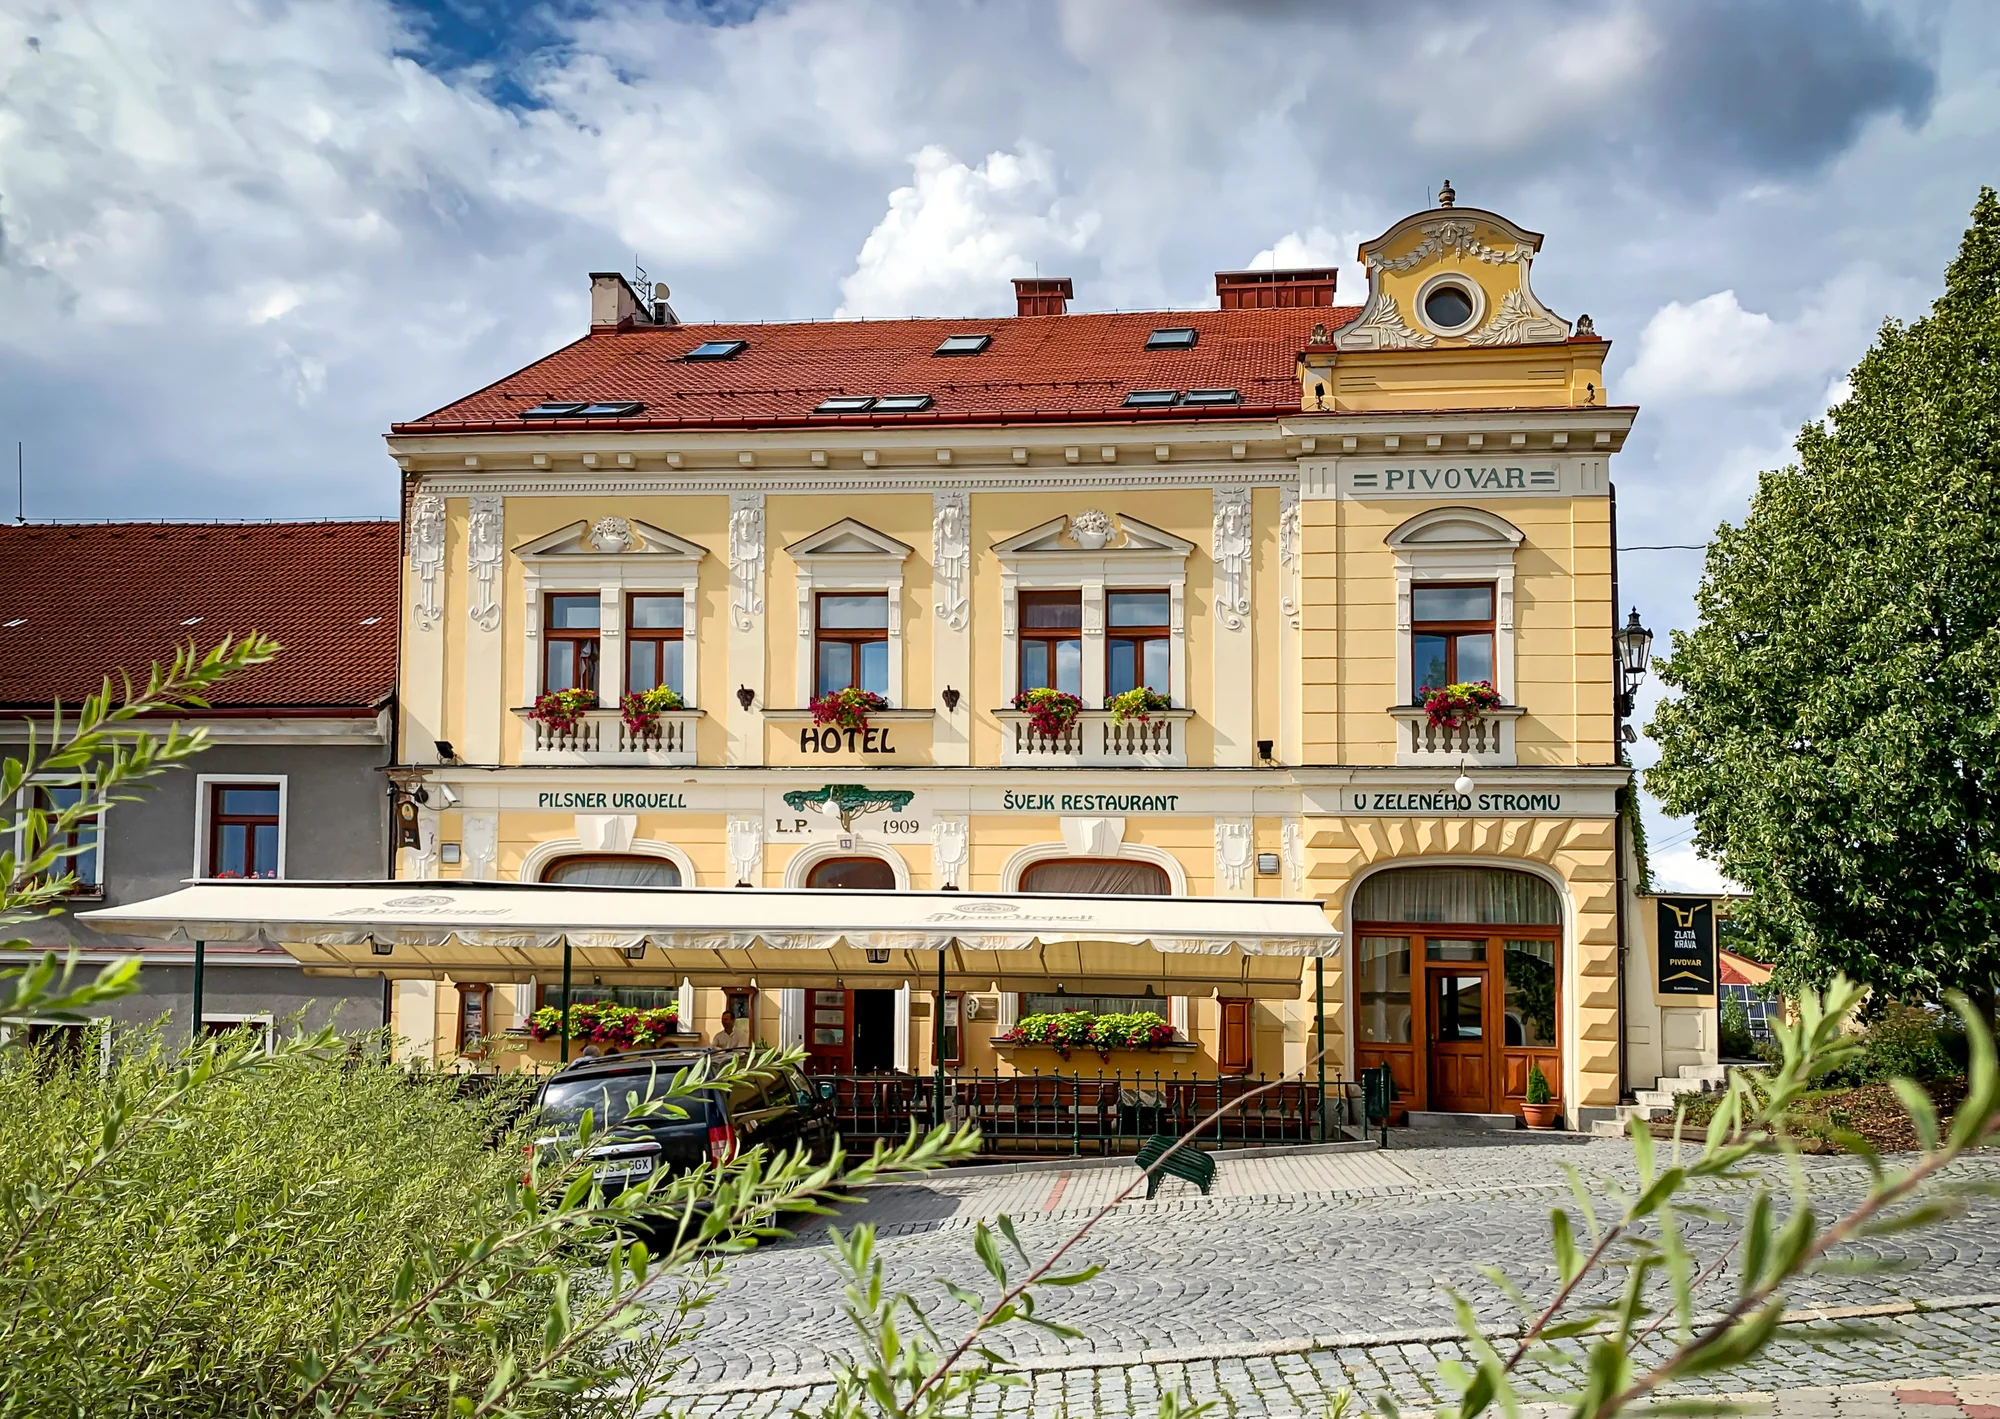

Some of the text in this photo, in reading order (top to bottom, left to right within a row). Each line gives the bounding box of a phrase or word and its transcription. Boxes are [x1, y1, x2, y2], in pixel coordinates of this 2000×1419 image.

[1385, 467, 1526, 491] PIVOVAR
[800, 727, 896, 754] HOTEL
[538, 792, 687, 809] PILSNER URQUELL
[1003, 789, 1179, 811] ŠVEJK RESTAURANT
[1354, 788, 1561, 811] U ZELENÉHO STROMU
[883, 820, 919, 834] 1909
[1674, 930, 1696, 940] ZLATÁ
[1674, 939, 1697, 949] KRÁVA
[1669, 958, 1702, 966] PIVOVAR
